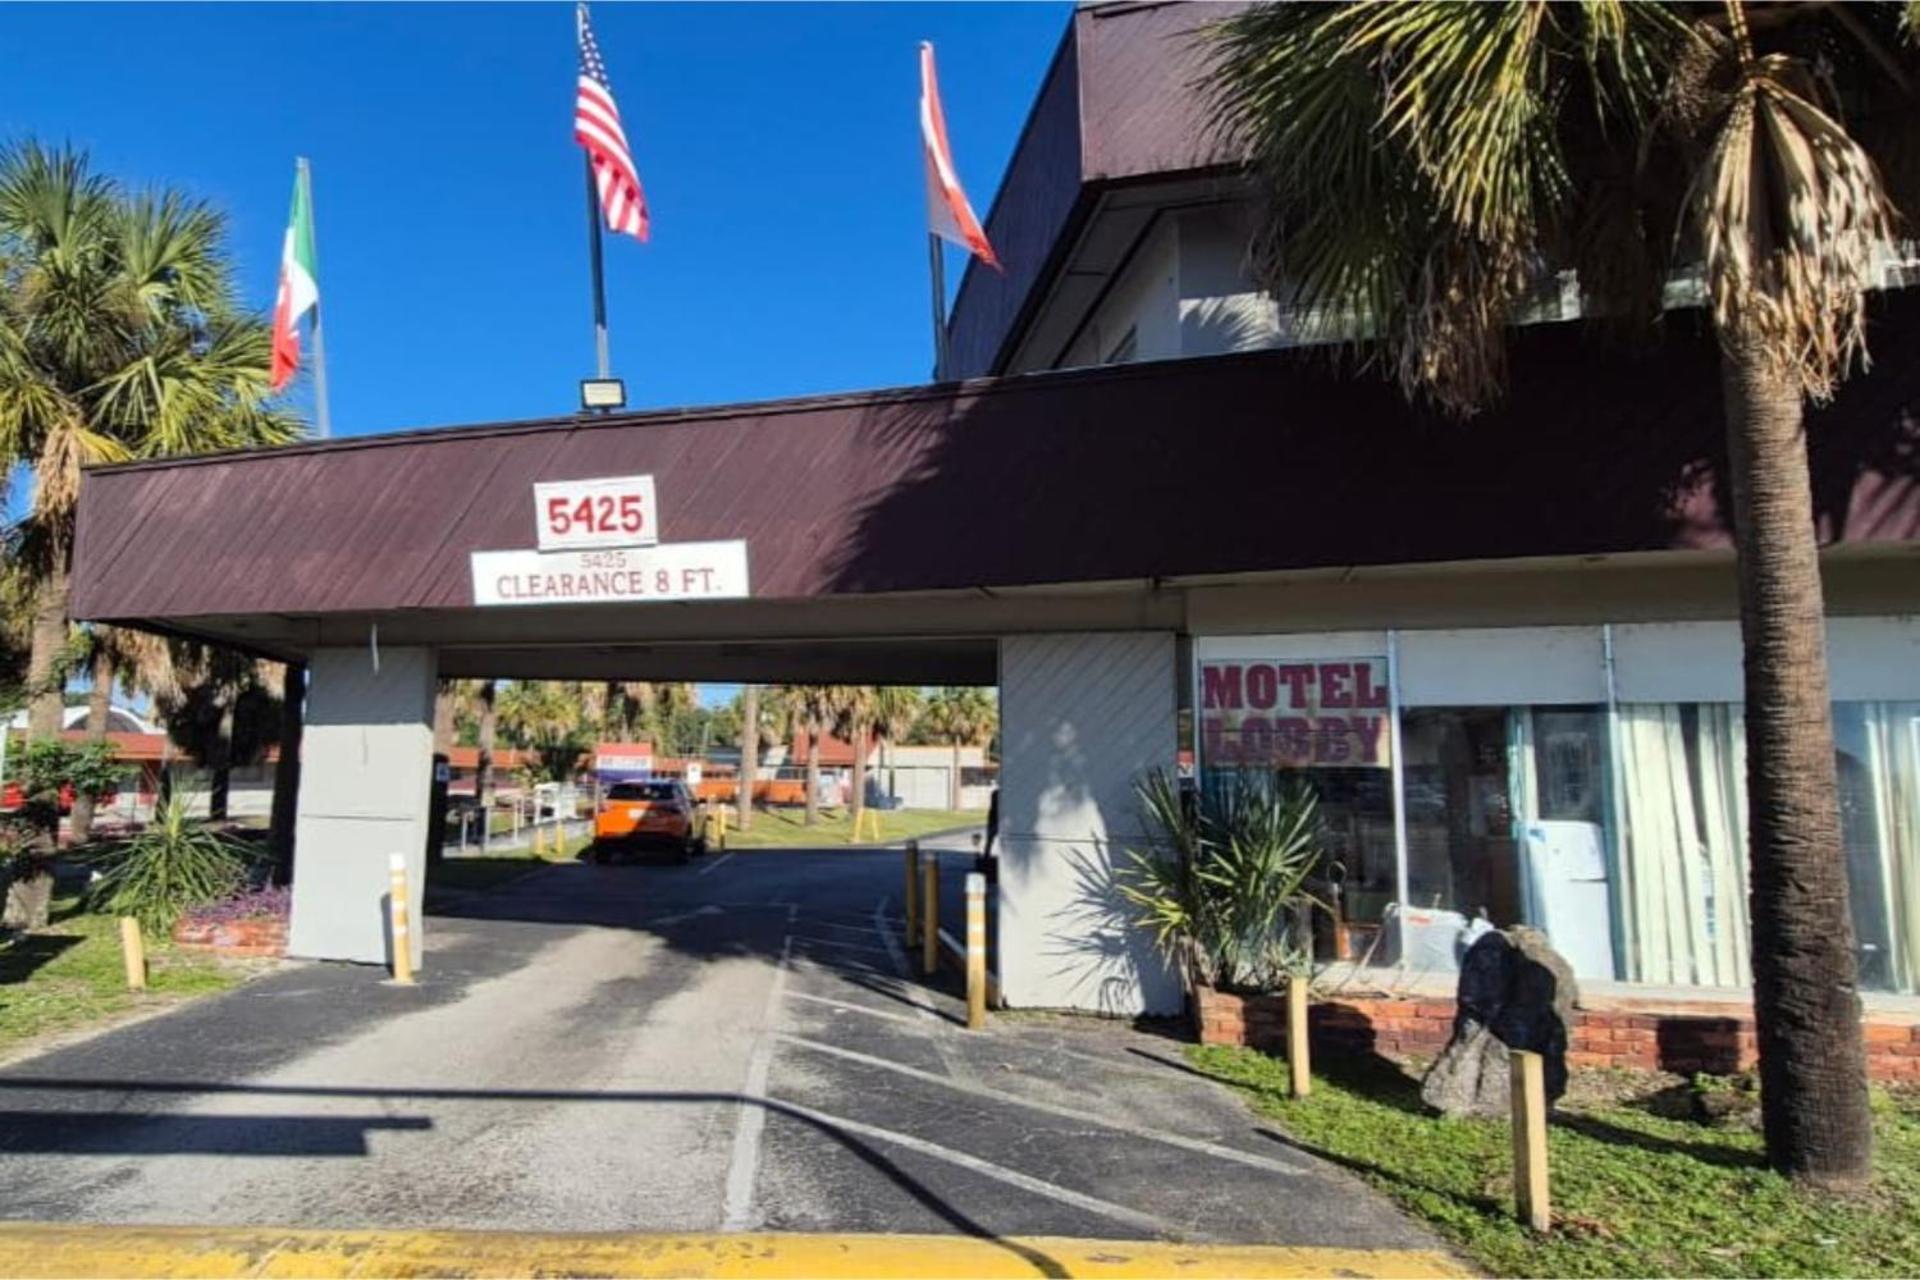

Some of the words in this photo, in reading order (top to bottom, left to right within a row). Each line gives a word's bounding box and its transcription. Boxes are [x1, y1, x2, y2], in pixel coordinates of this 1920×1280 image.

[548, 496, 643, 534] 5425
[580, 551, 627, 568] 5425
[497, 571, 643, 598] CLEARANCE
[655, 568, 670, 592] 8
[682, 568, 723, 592] FT.
[1203, 663, 1388, 709] MOTEL
[1205, 716, 1381, 763] LOBBY
